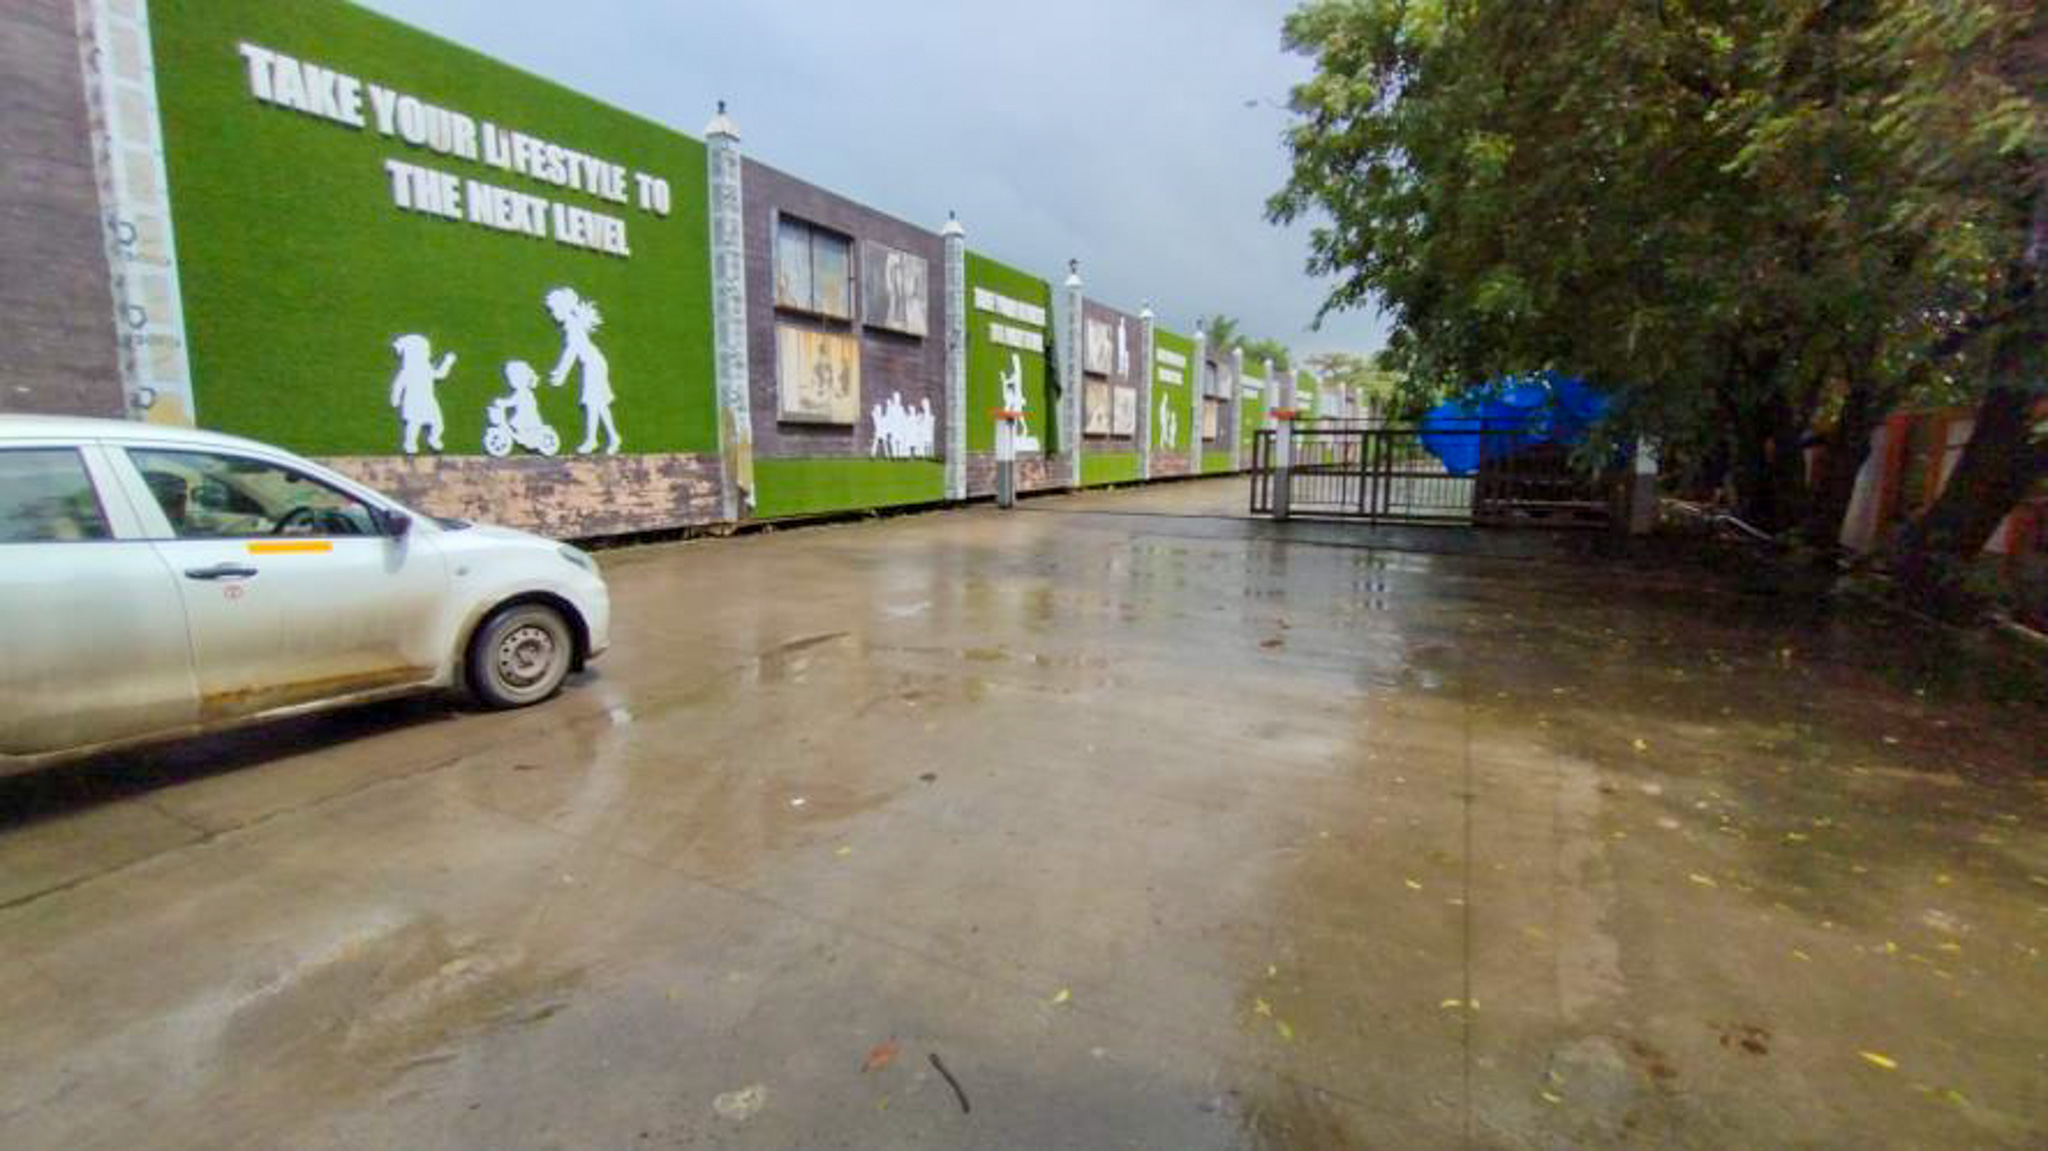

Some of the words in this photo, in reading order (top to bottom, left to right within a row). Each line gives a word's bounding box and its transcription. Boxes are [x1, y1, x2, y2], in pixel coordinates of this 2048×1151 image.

[239, 43, 365, 127] TAKE
[369, 84, 477, 158] YOUR
[633, 172, 670, 215] TO
[385, 160, 462, 218] THE
[466, 179, 548, 237] NEXT
[553, 203, 630, 256] LEVEL
